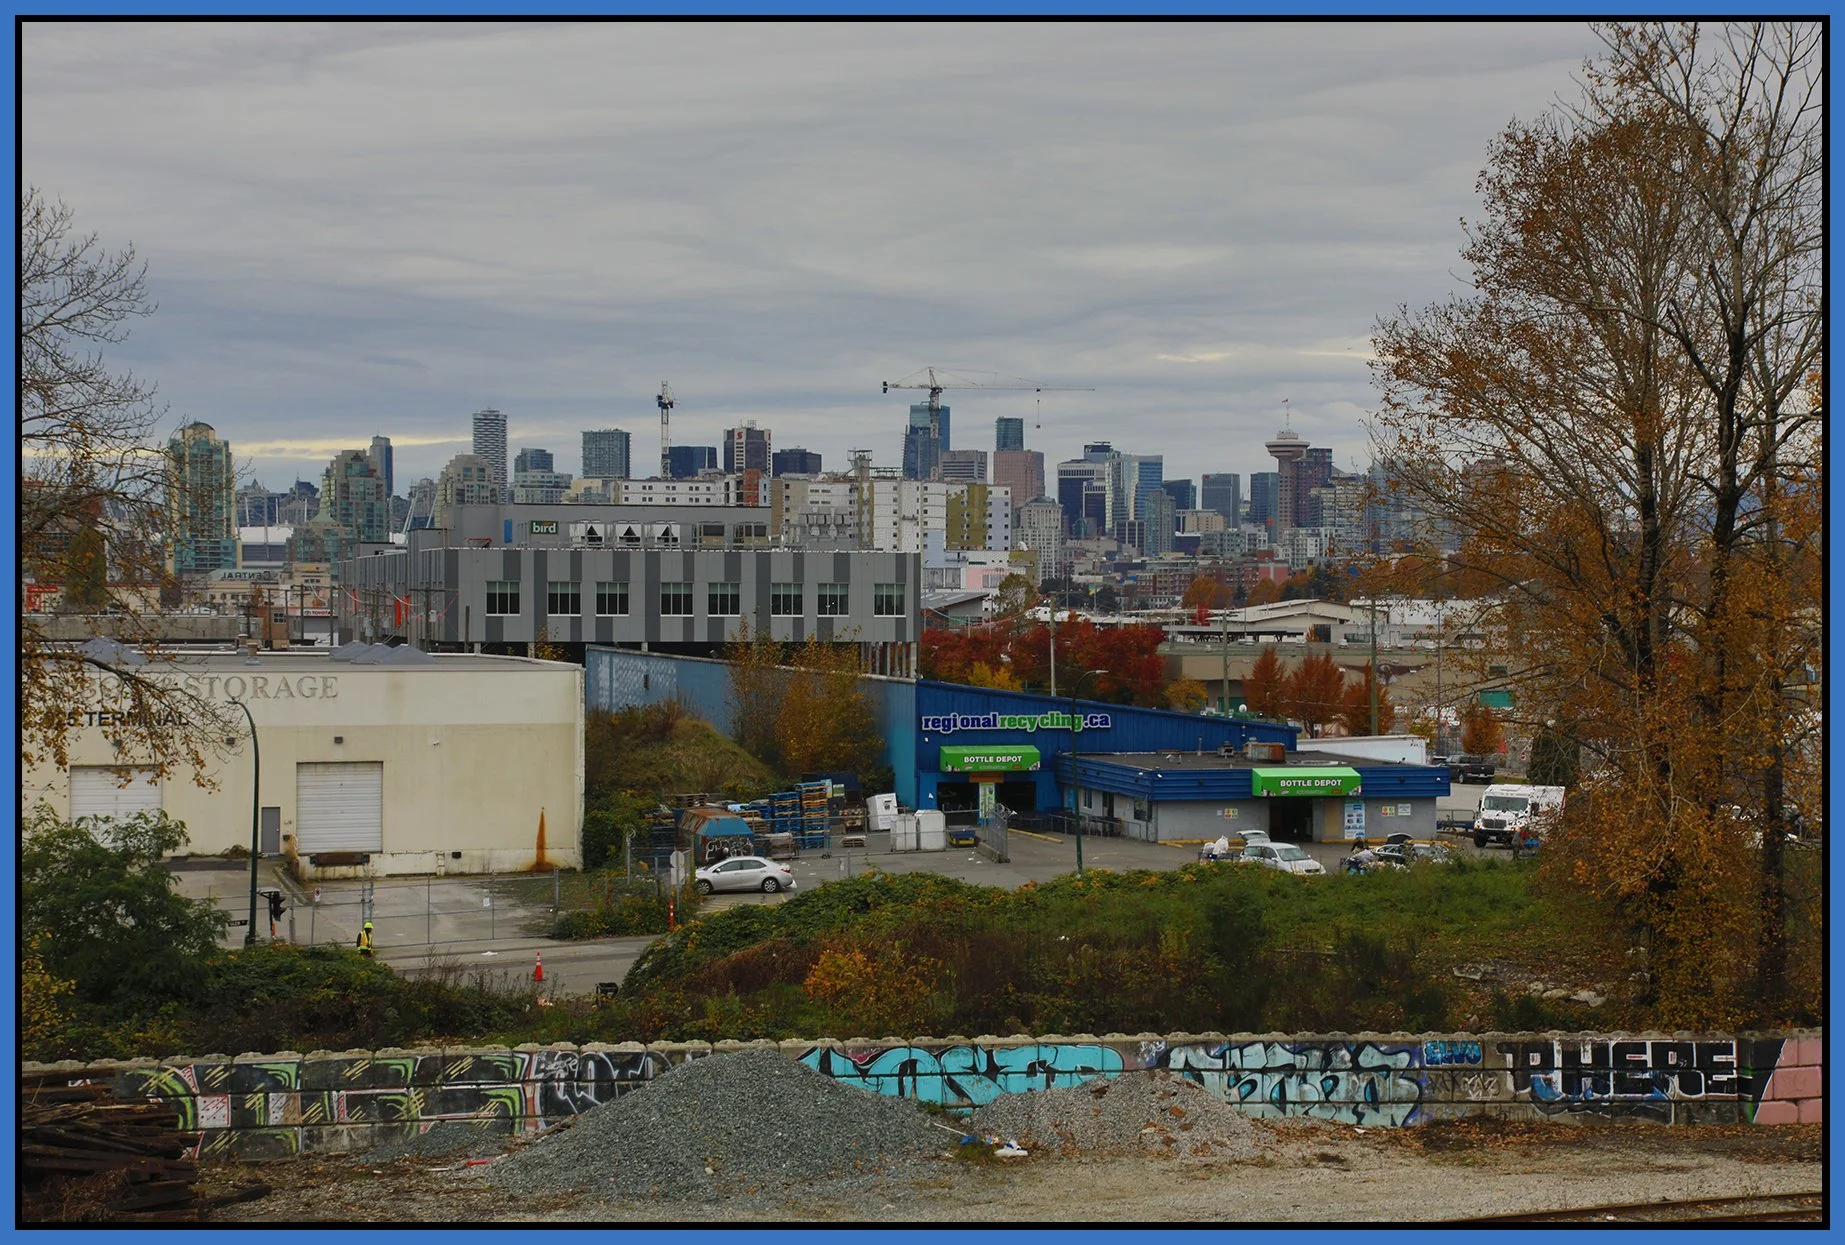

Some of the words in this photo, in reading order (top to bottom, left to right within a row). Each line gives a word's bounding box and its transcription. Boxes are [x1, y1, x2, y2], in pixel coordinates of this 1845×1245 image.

[532, 522, 556, 533] bird
[184, 675, 339, 700] STORAGE
[996, 755, 1023, 763] DEPOT
[1280, 779, 1312, 787] BOTTLE
[1314, 778, 1342, 787] DEPOT
